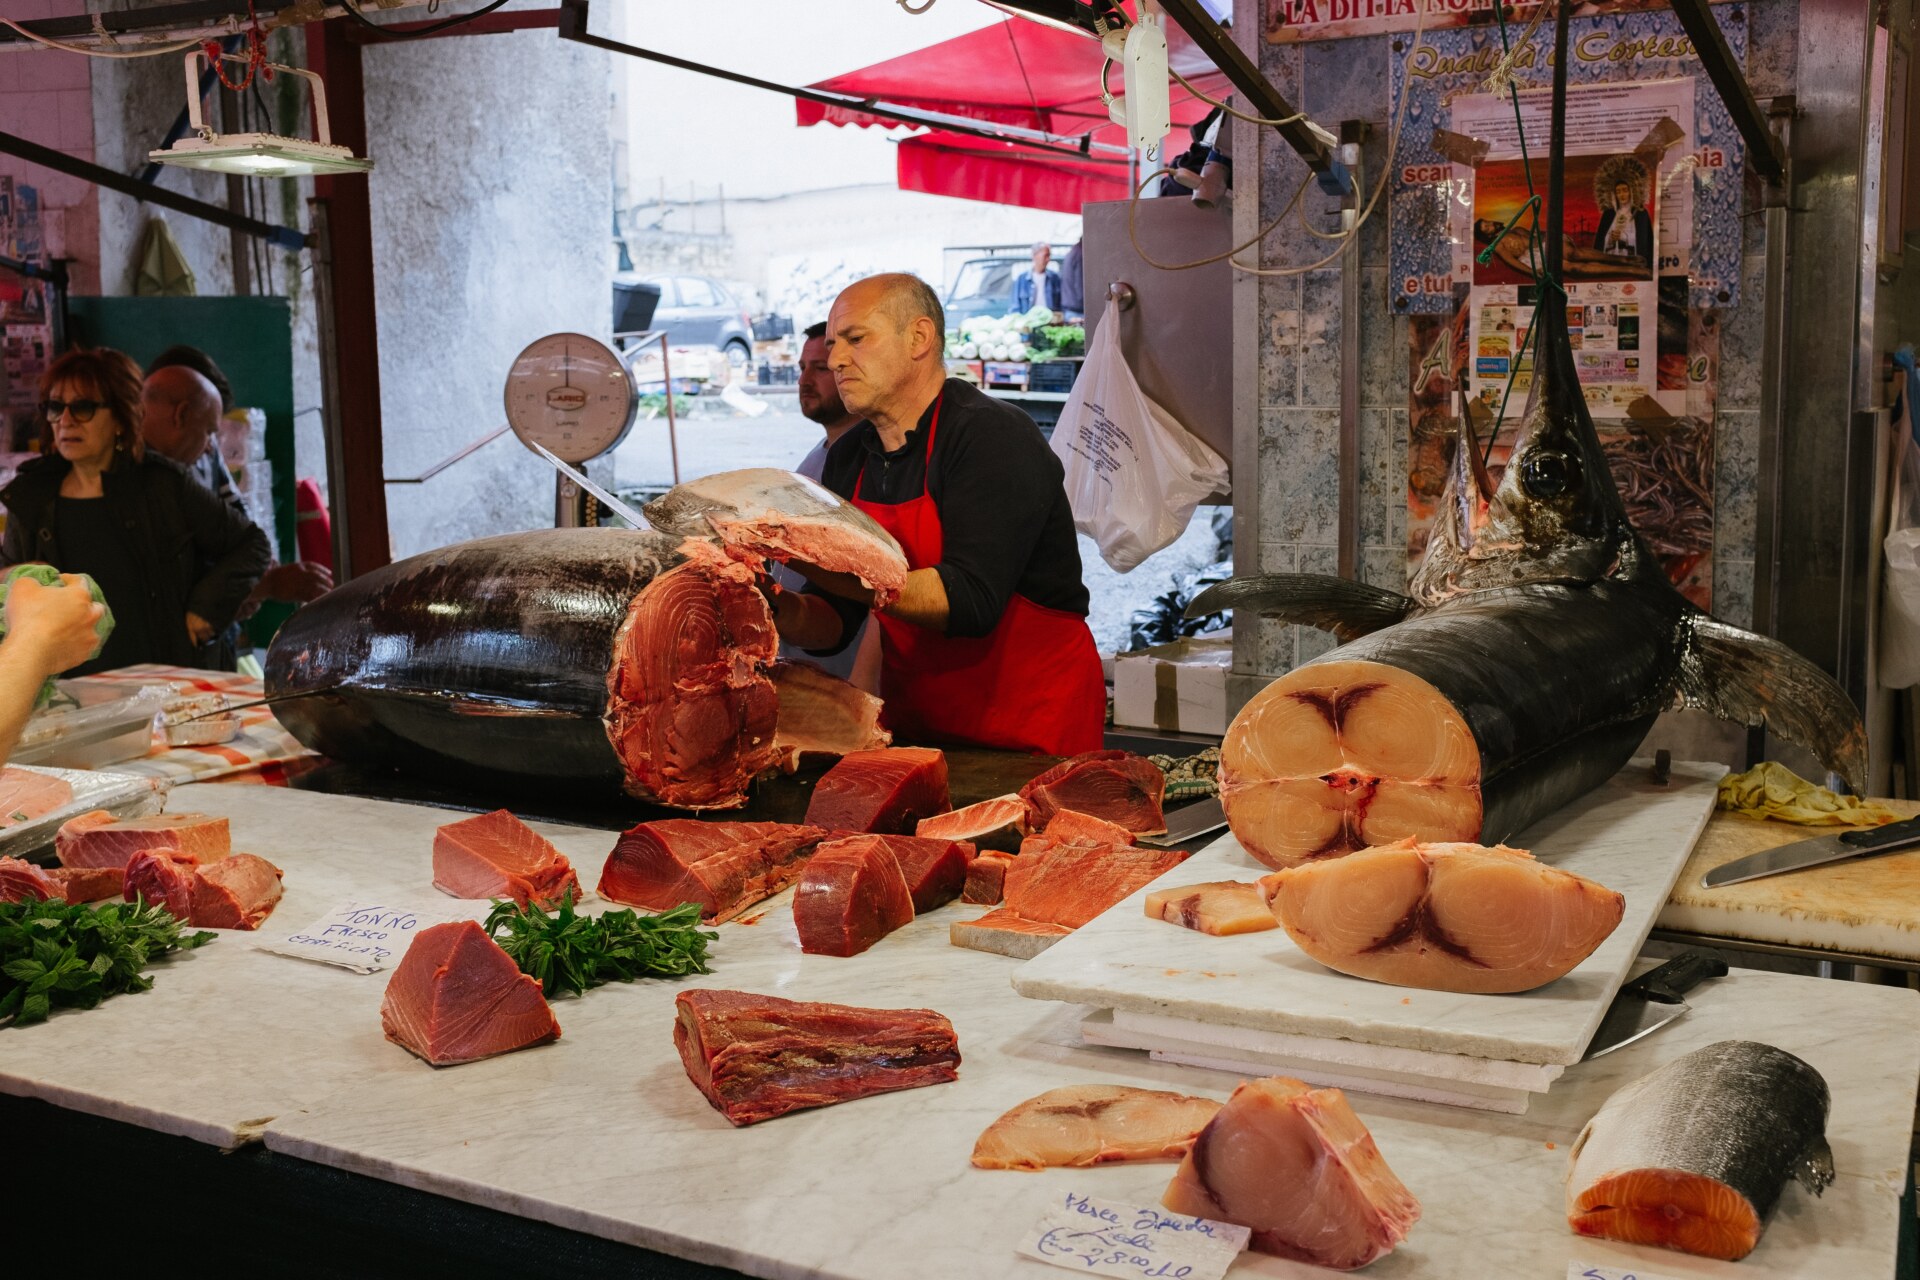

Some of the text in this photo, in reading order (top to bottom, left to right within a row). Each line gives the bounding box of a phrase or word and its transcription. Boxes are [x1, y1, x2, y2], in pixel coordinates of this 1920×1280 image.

[1284, 0, 1318, 25] LA
[1406, 279, 1418, 293] e
[336, 906, 417, 930] TONNO
[323, 924, 389, 940] FRESCO
